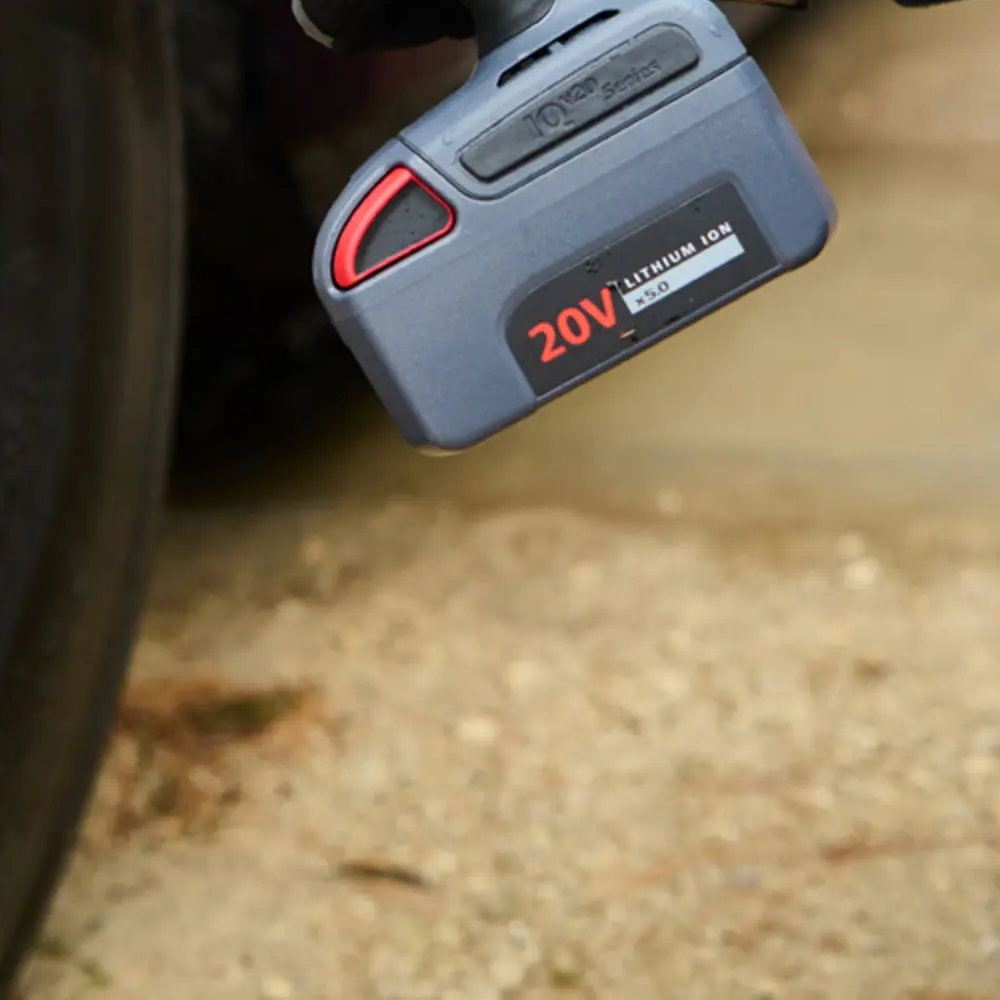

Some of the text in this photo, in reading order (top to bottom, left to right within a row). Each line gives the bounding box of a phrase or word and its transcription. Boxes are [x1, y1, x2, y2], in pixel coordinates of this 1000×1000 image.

[623, 220, 734, 290] LITHIUM ION
[527, 286, 618, 364] 20V
